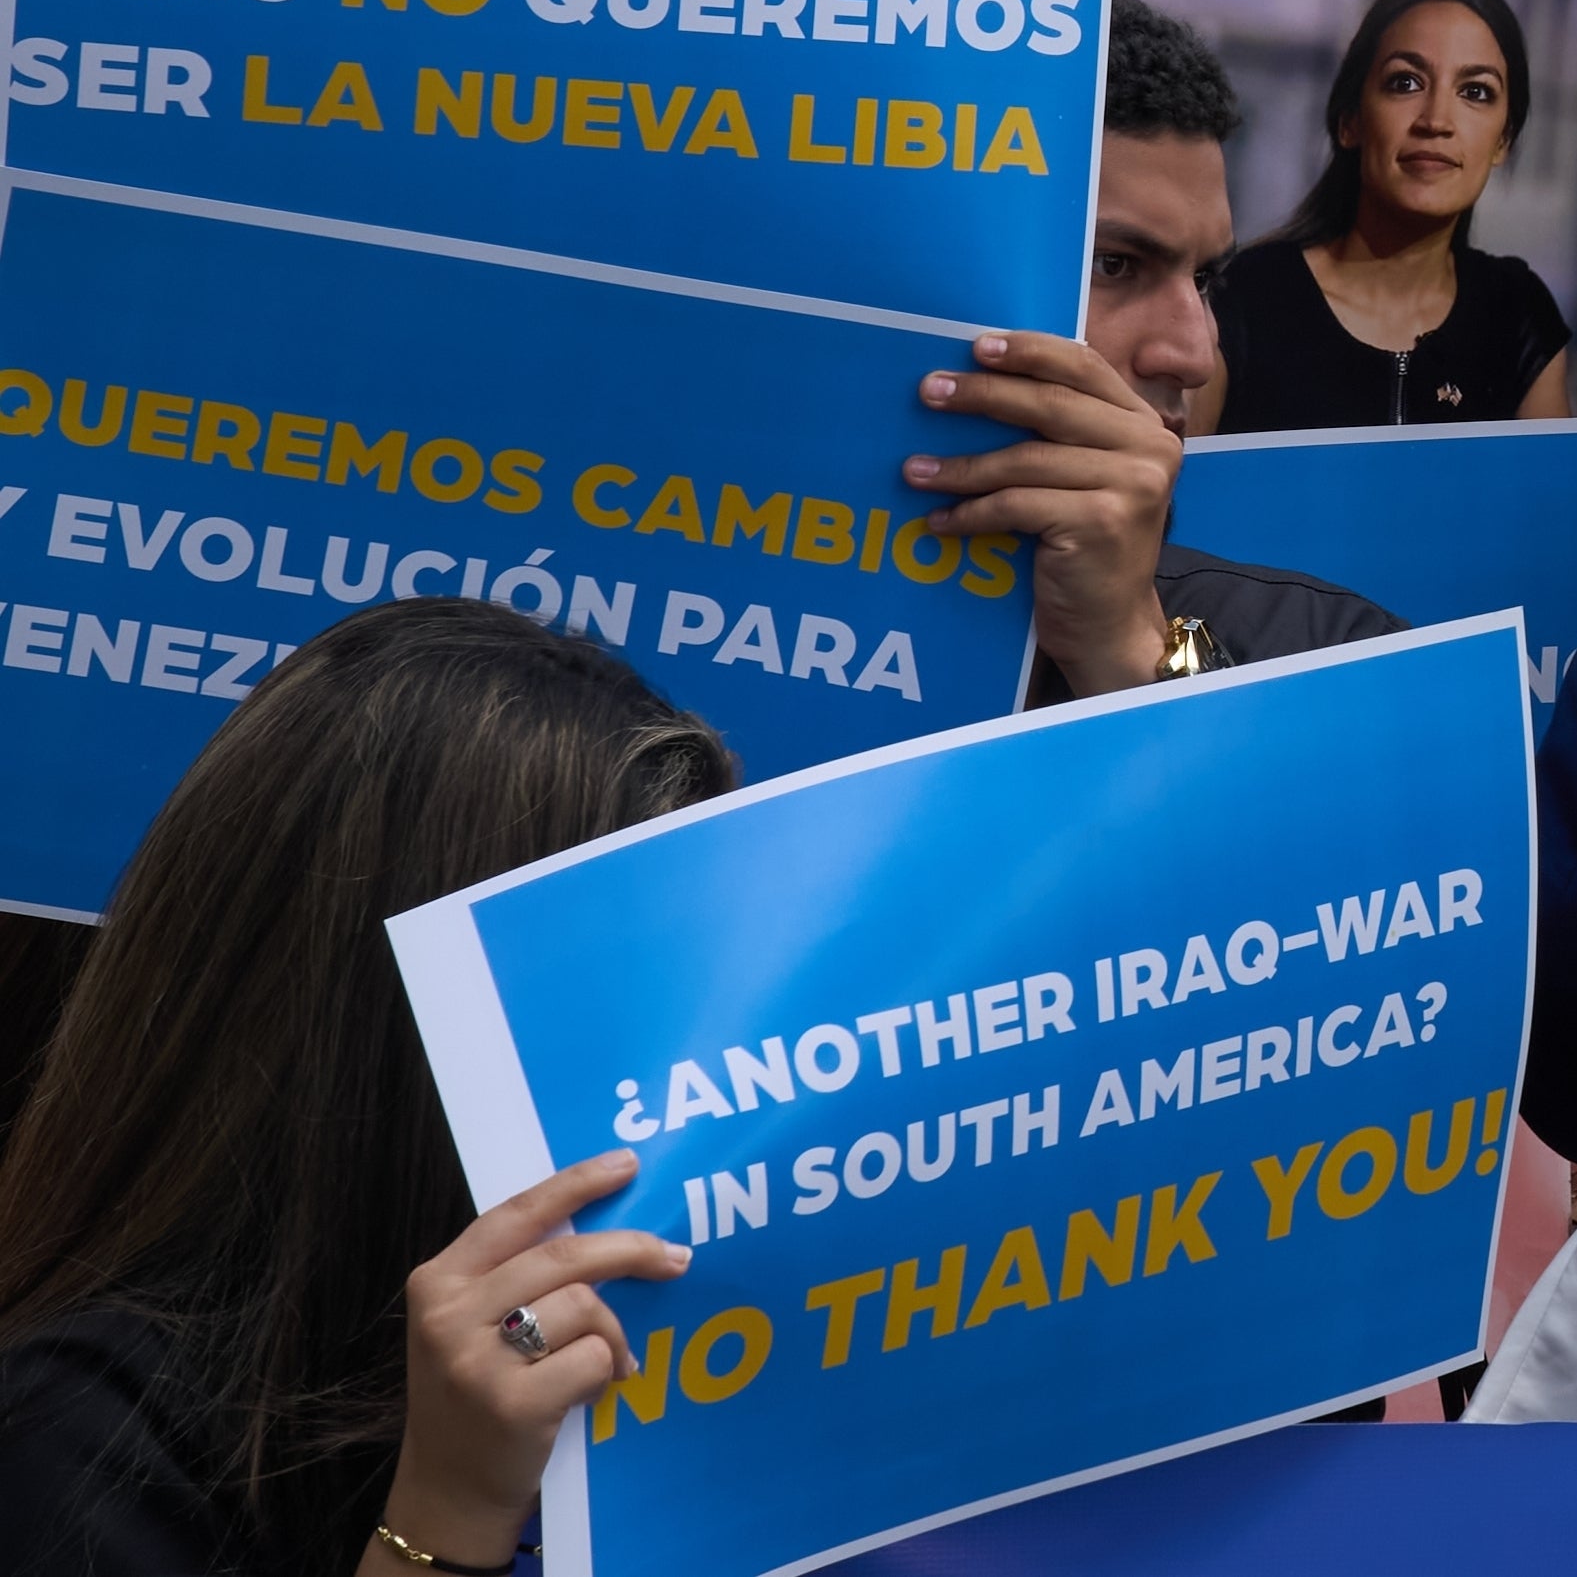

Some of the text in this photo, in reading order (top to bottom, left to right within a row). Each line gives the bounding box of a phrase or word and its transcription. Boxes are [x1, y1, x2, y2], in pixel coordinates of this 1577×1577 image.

[9, 37, 1049, 177] SER LA NUEVA LIBIA
[0, 369, 1020, 598] QUEREMOS CAMBIOS
[0, 602, 298, 701] ENEZ
[48, 493, 922, 702] EVOLUCIÓN PARA
[614, 971, 1075, 1142] ¿ANOTHER
[683, 981, 1447, 1246] IN SOUTH AMERICA?
[592, 1088, 1506, 1445] NO THANK YOU!
